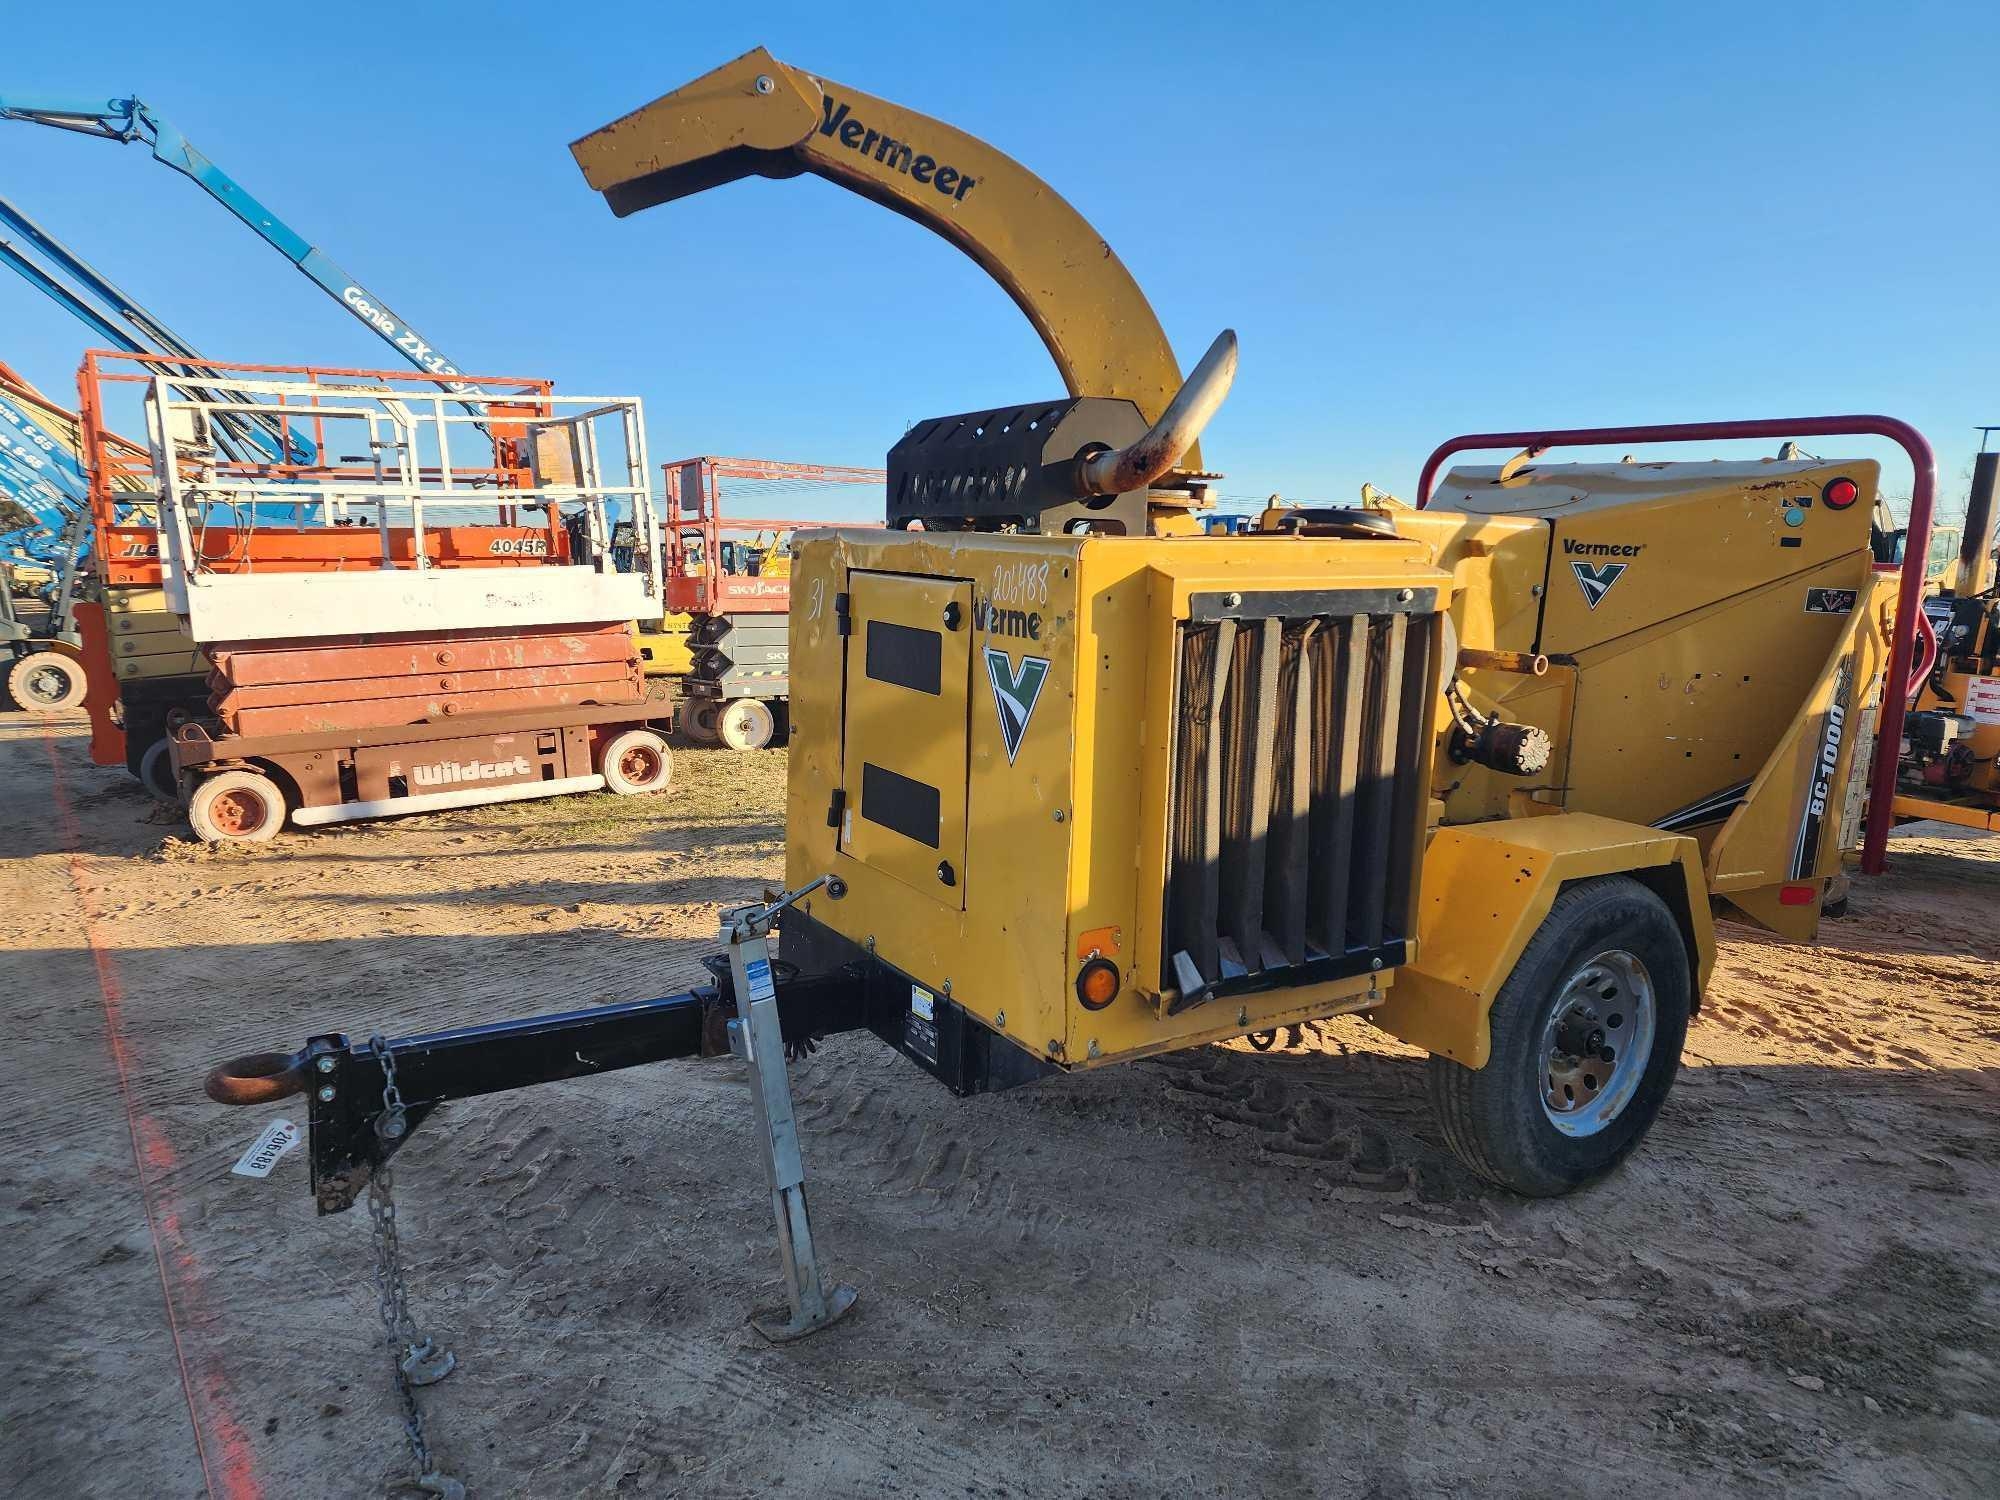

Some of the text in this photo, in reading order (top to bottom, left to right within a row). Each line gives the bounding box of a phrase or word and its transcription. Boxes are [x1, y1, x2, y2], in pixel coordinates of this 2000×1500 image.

[819, 95, 976, 201] Vermeer
[344, 286, 395, 336] Genie
[22, 425, 54, 451] S-65
[489, 539, 547, 555] 4045R
[1563, 538, 1642, 557] Vermeer
[808, 576, 824, 622] 31
[993, 560, 1049, 606] 206488
[412, 755, 531, 786] Wildcat
[250, 1130, 293, 1170] 206488
